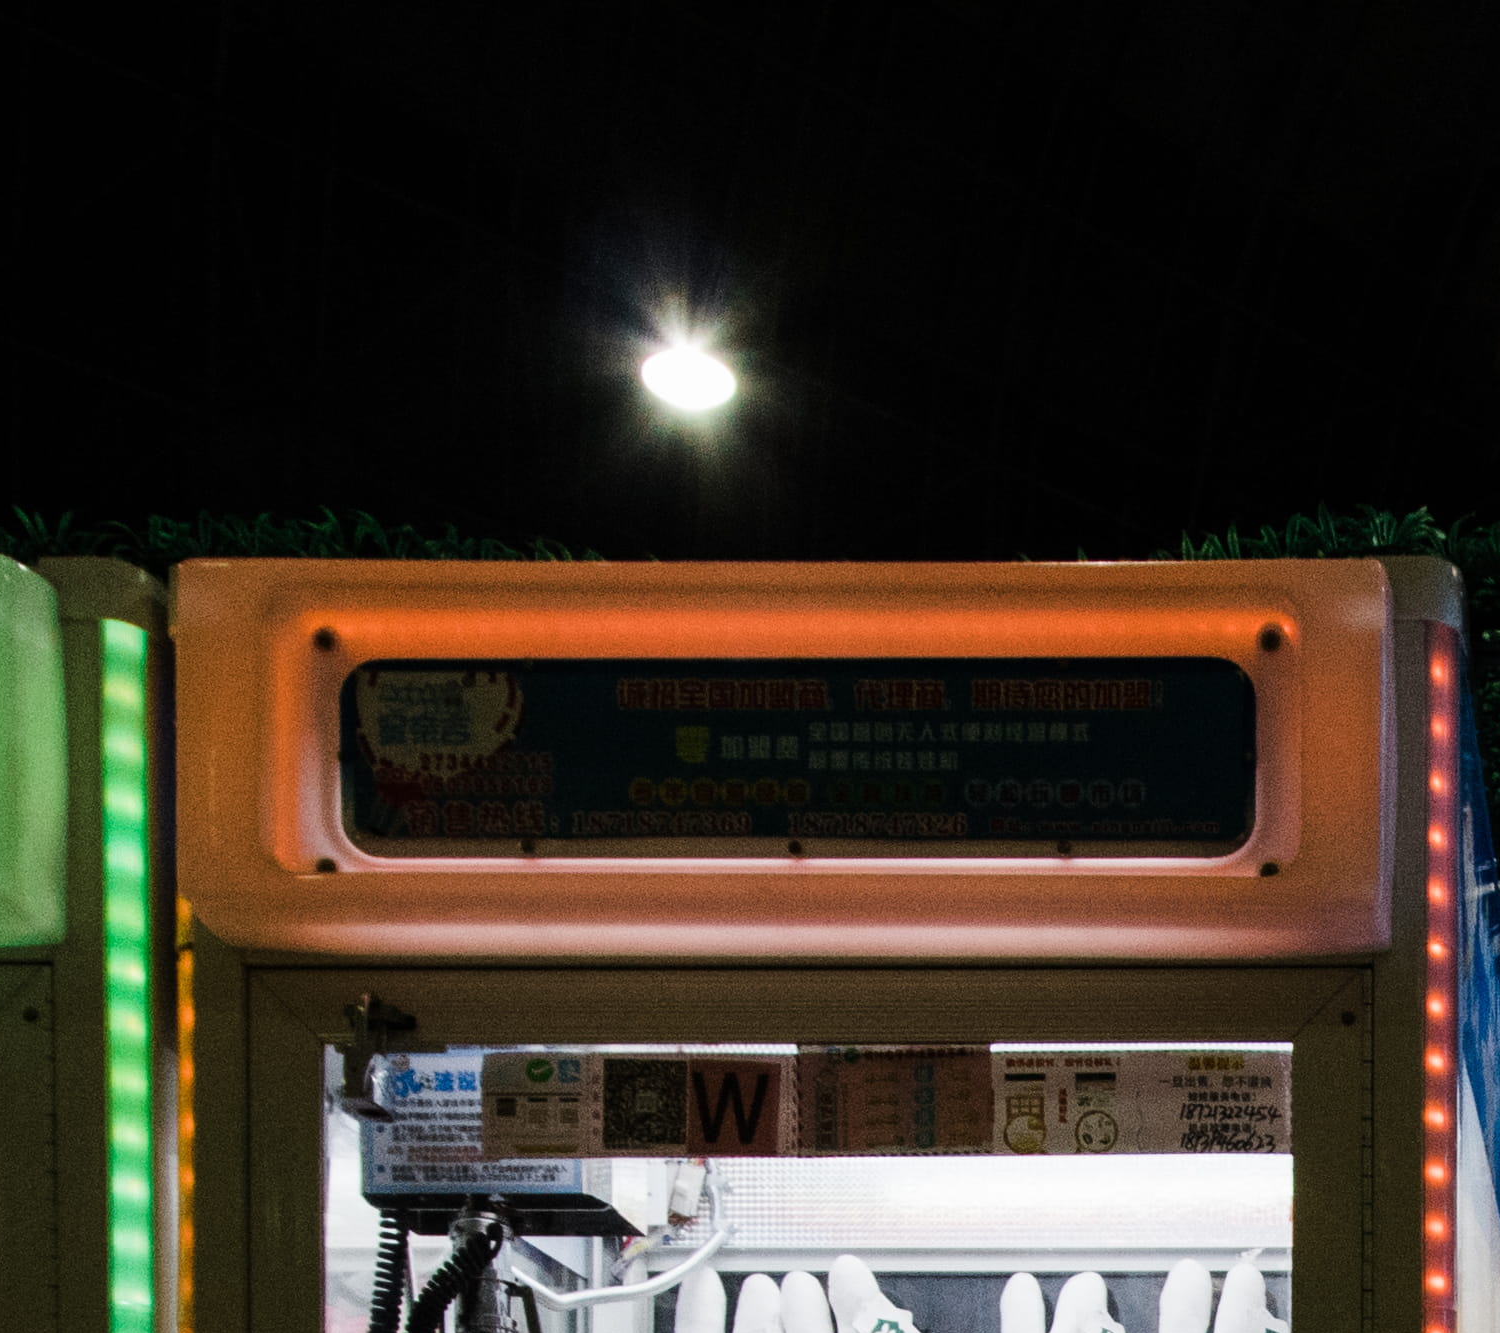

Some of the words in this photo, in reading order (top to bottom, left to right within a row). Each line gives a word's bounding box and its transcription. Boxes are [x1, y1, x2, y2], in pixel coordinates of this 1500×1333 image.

[393, 1069, 476, 1097] 玩法说
[692, 1071, 770, 1144] W
